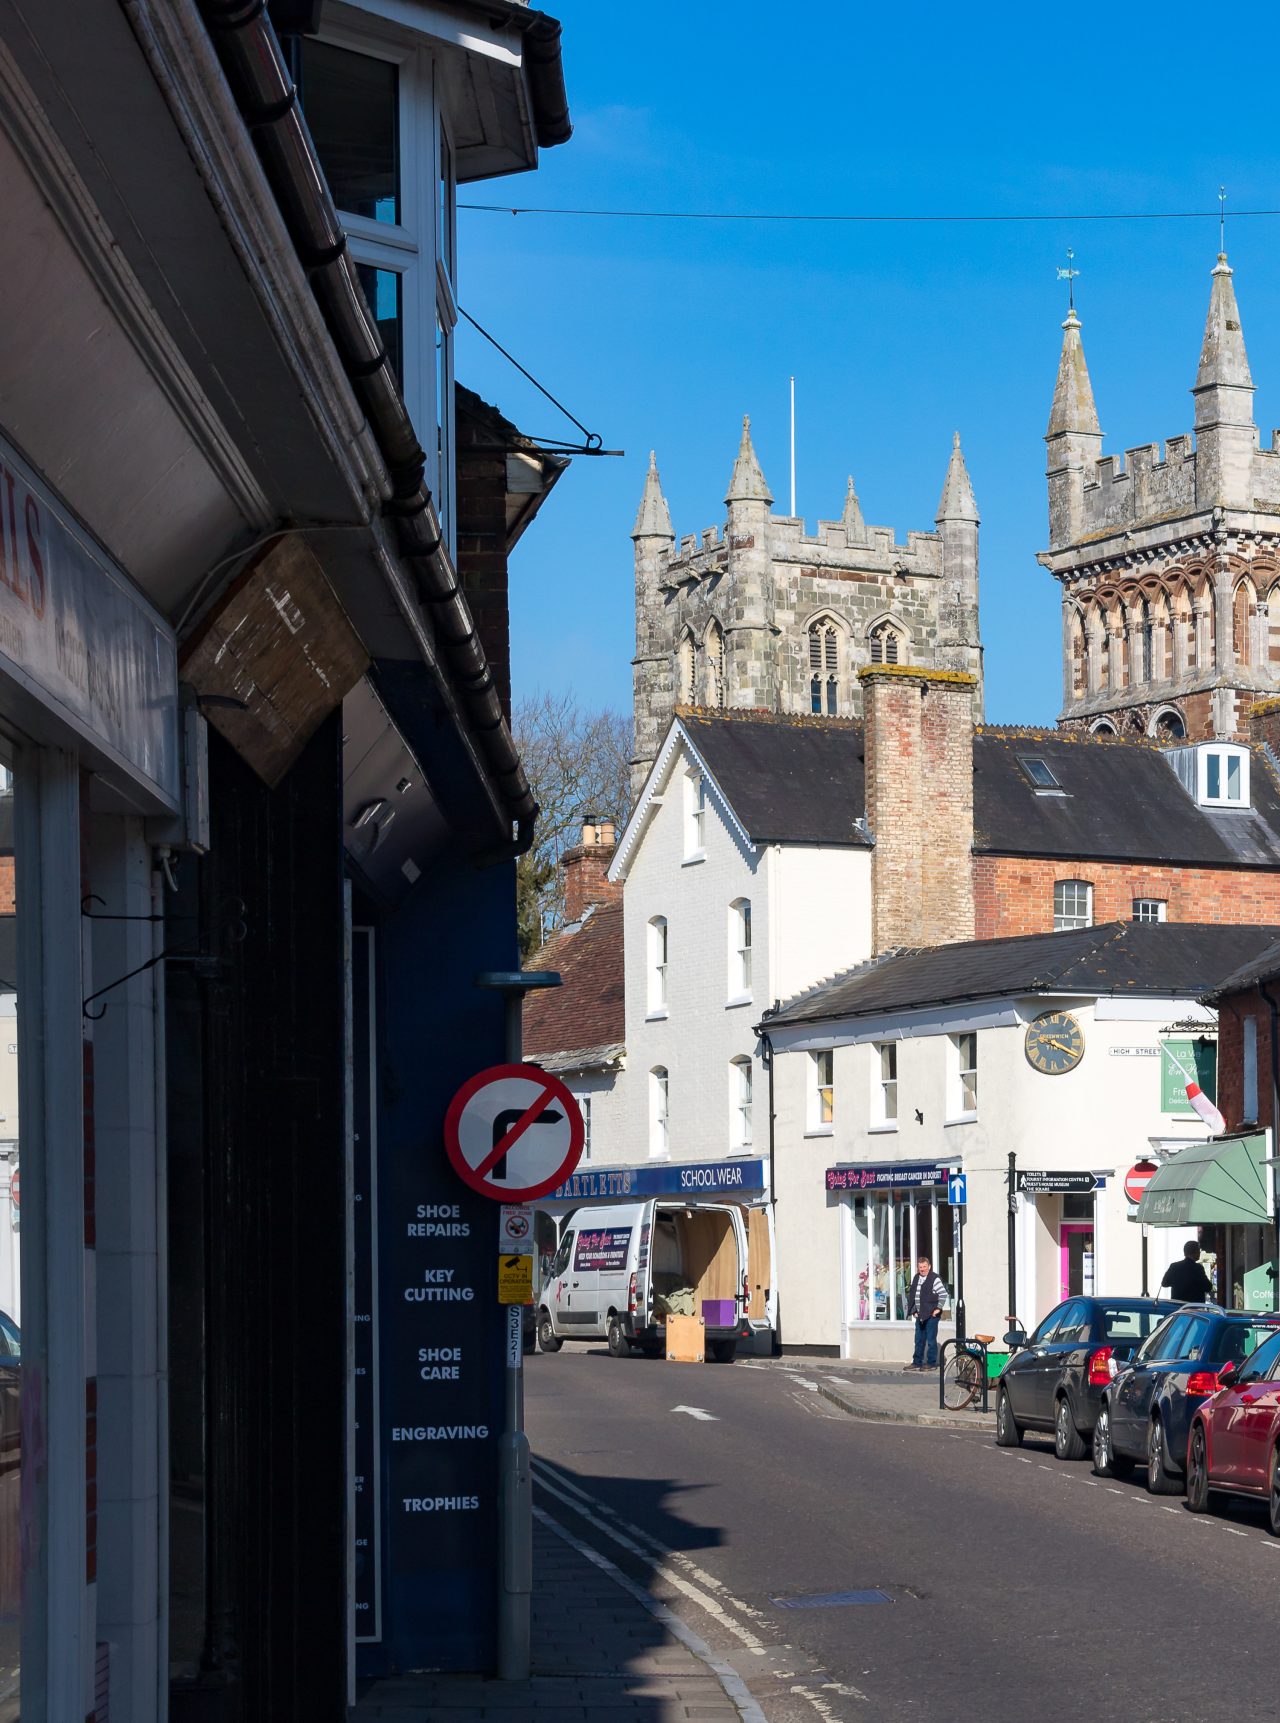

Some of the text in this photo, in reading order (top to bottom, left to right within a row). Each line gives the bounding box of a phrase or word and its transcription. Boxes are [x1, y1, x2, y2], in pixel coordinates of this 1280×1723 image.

[1176, 1050, 1186, 1058] La
[1173, 1088, 1187, 1096] Fre
[681, 1167, 743, 1187] SCHOOL WEAR
[556, 1172, 631, 1198] BARTLETTS
[416, 1205, 460, 1218] SHOE
[407, 1223, 470, 1237] REPAIRS
[425, 1270, 454, 1283] KEY
[404, 1288, 474, 1301] CUTTING
[418, 1348, 461, 1362] SHOE
[421, 1367, 460, 1380] CARE
[392, 1426, 489, 1441] ENGRAVING
[403, 1496, 479, 1511] TROPHIES
